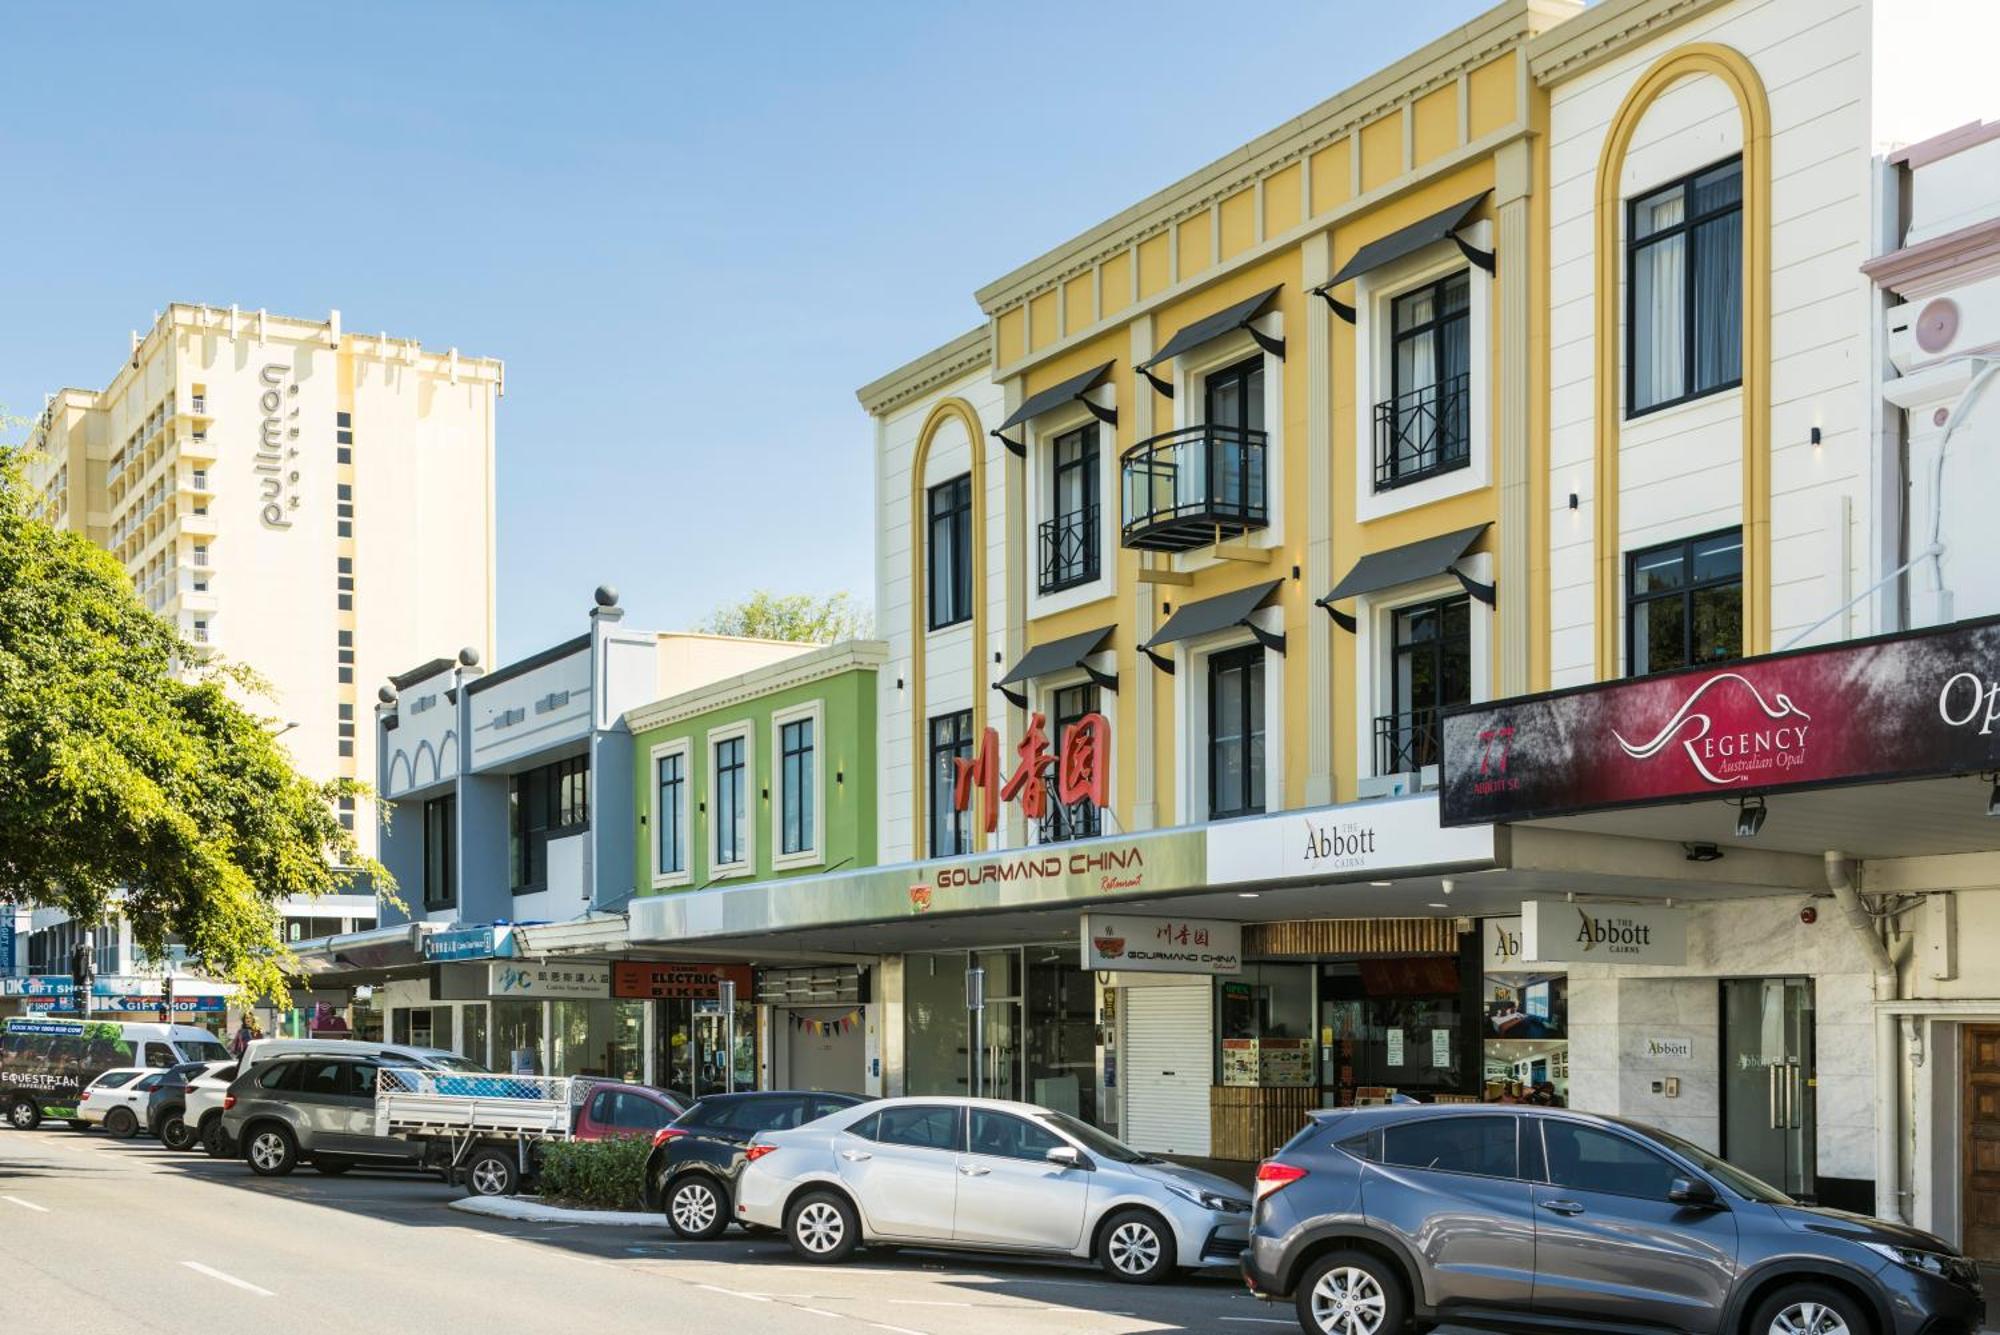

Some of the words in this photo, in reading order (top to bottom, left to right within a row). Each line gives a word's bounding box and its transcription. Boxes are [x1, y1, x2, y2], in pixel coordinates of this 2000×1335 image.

[255, 363, 292, 528] pullman
[1476, 727, 1516, 775] 77
[1683, 714, 1808, 783] REGENCY
[1718, 753, 1773, 774] Australian
[1776, 748, 1805, 771] Opal
[1343, 823, 1358, 832] THE
[1304, 827, 1375, 859] Abbott
[937, 858, 1061, 887] GOURMAND
[1069, 847, 1143, 874] CHINA
[1334, 856, 1365, 868] CAIRNS
[1100, 873, 1143, 891] Restaurant
[1617, 919, 1633, 927] THE
[1576, 918, 1650, 945] Abbott
[1128, 951, 1197, 962] GOURMAND
[1201, 954, 1237, 963] CHINA
[1609, 946, 1639, 954] CAIRNS
[6, 978, 25, 994] OK
[29, 985, 53, 994] GIFT
[652, 973, 717, 984] ELECTRIC
[652, 987, 717, 996] BIKES
[126, 1002, 157, 1011] GIFT
[1648, 1040, 1687, 1055] Abbott
[1, 1071, 79, 1088] EQUESTRIAN
